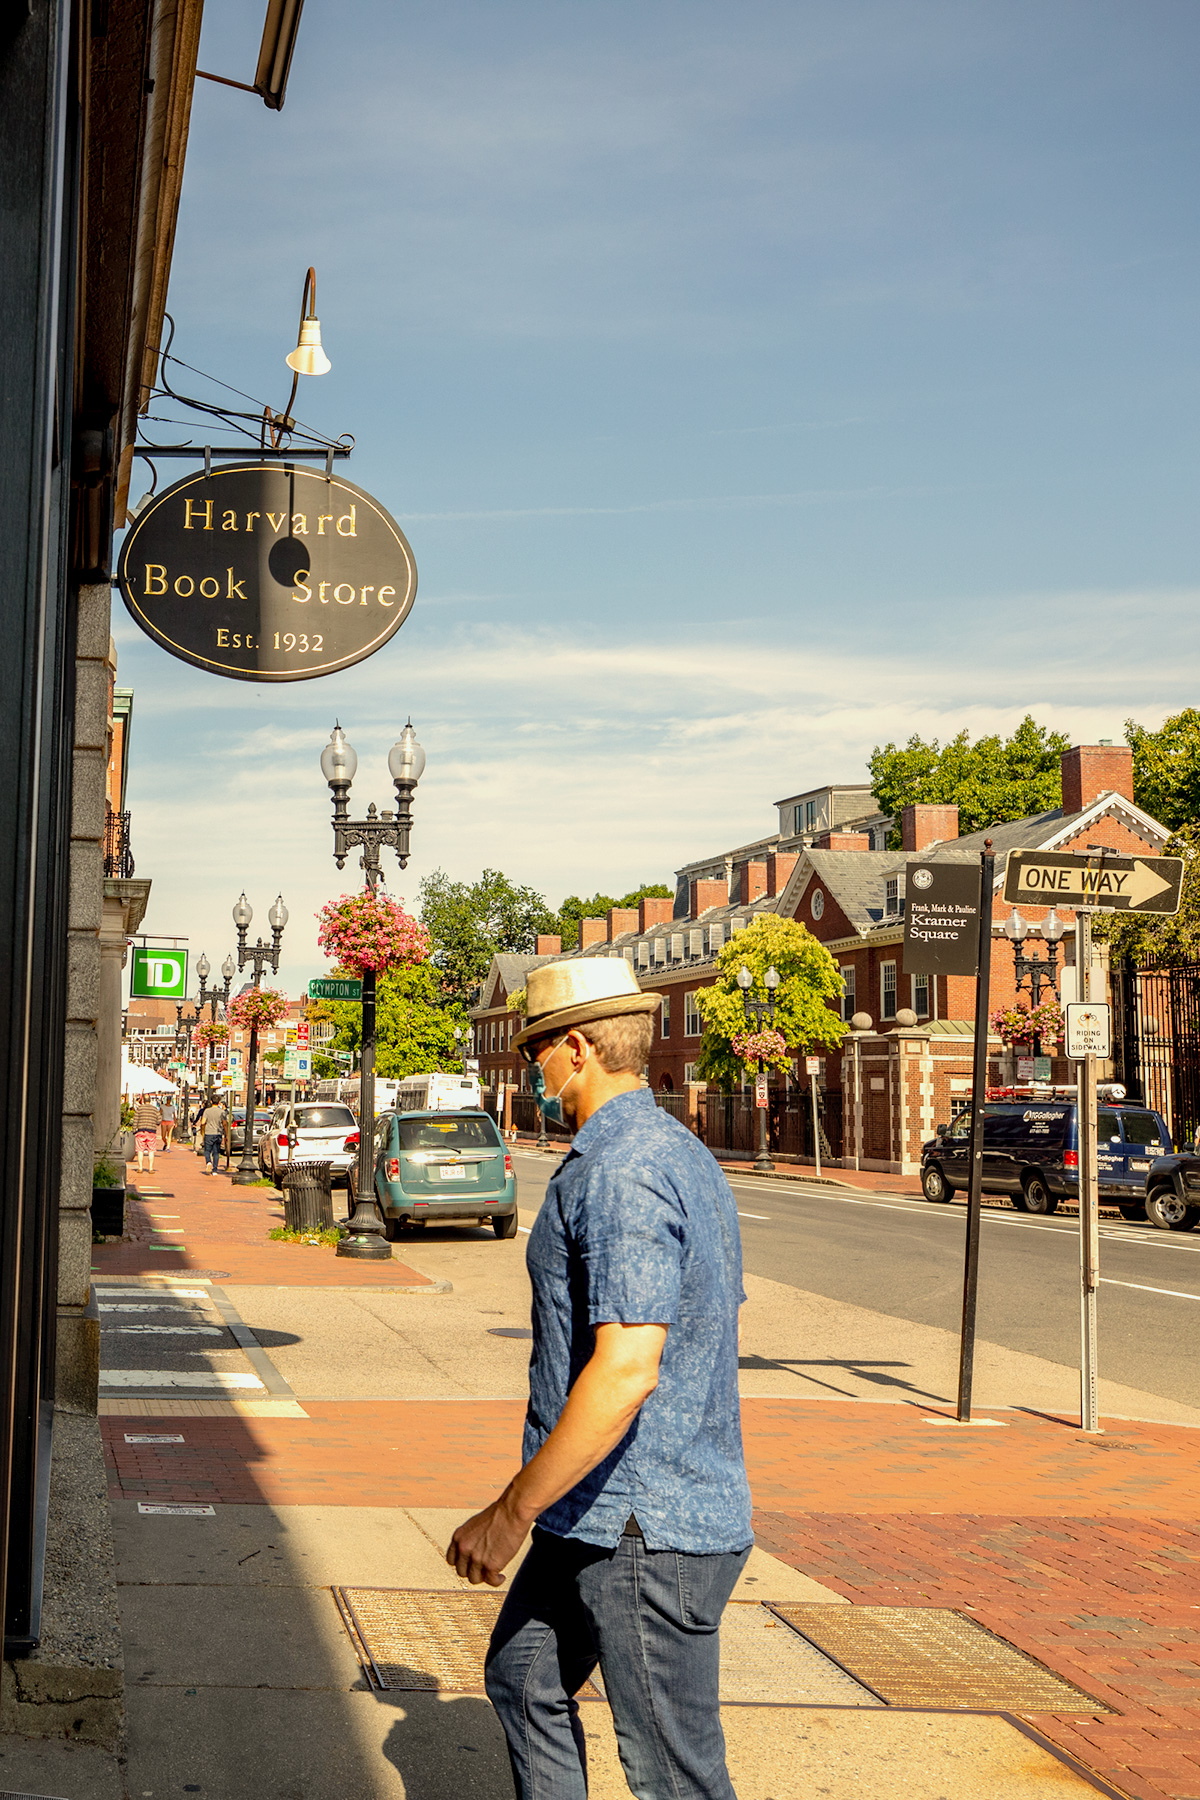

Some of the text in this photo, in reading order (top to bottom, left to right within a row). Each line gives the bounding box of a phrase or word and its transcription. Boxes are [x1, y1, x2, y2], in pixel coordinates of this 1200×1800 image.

[183, 499, 358, 537] Harvard
[143, 564, 396, 607] Book Store
[216, 628, 324, 652] Est. 1932
[1025, 868, 1129, 893] ONE WAY
[910, 914, 967, 927] Kramer
[911, 903, 977, 914] Frank, Mark & Pauline
[909, 927, 959, 942] Square
[138, 957, 181, 988] TD
[310, 982, 360, 997] PLYMPTON ST
